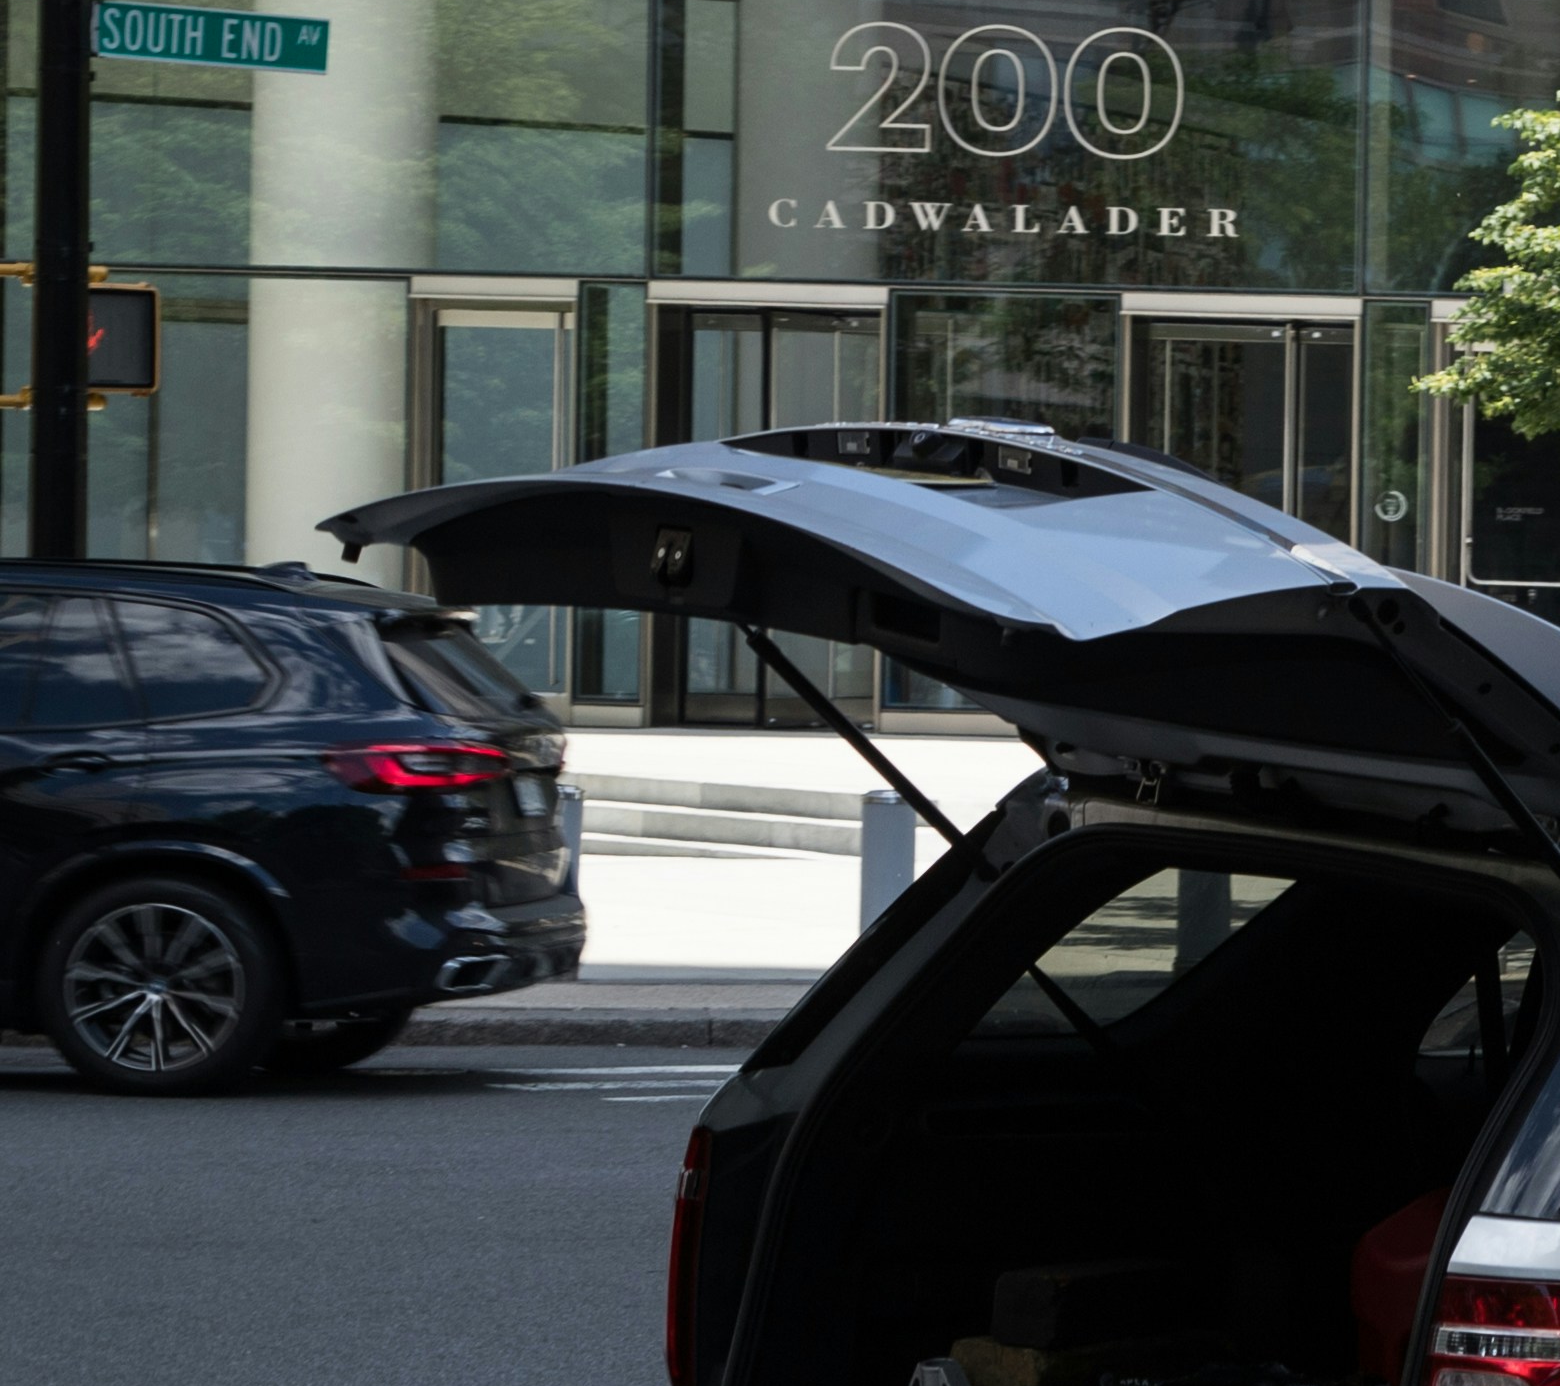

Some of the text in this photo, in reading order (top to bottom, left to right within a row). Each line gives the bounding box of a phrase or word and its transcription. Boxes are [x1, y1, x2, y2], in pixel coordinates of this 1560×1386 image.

[102, 8, 322, 61] SOUTH END AV
[826, 21, 1184, 160] 200
[767, 198, 1240, 238] CADWALADER
